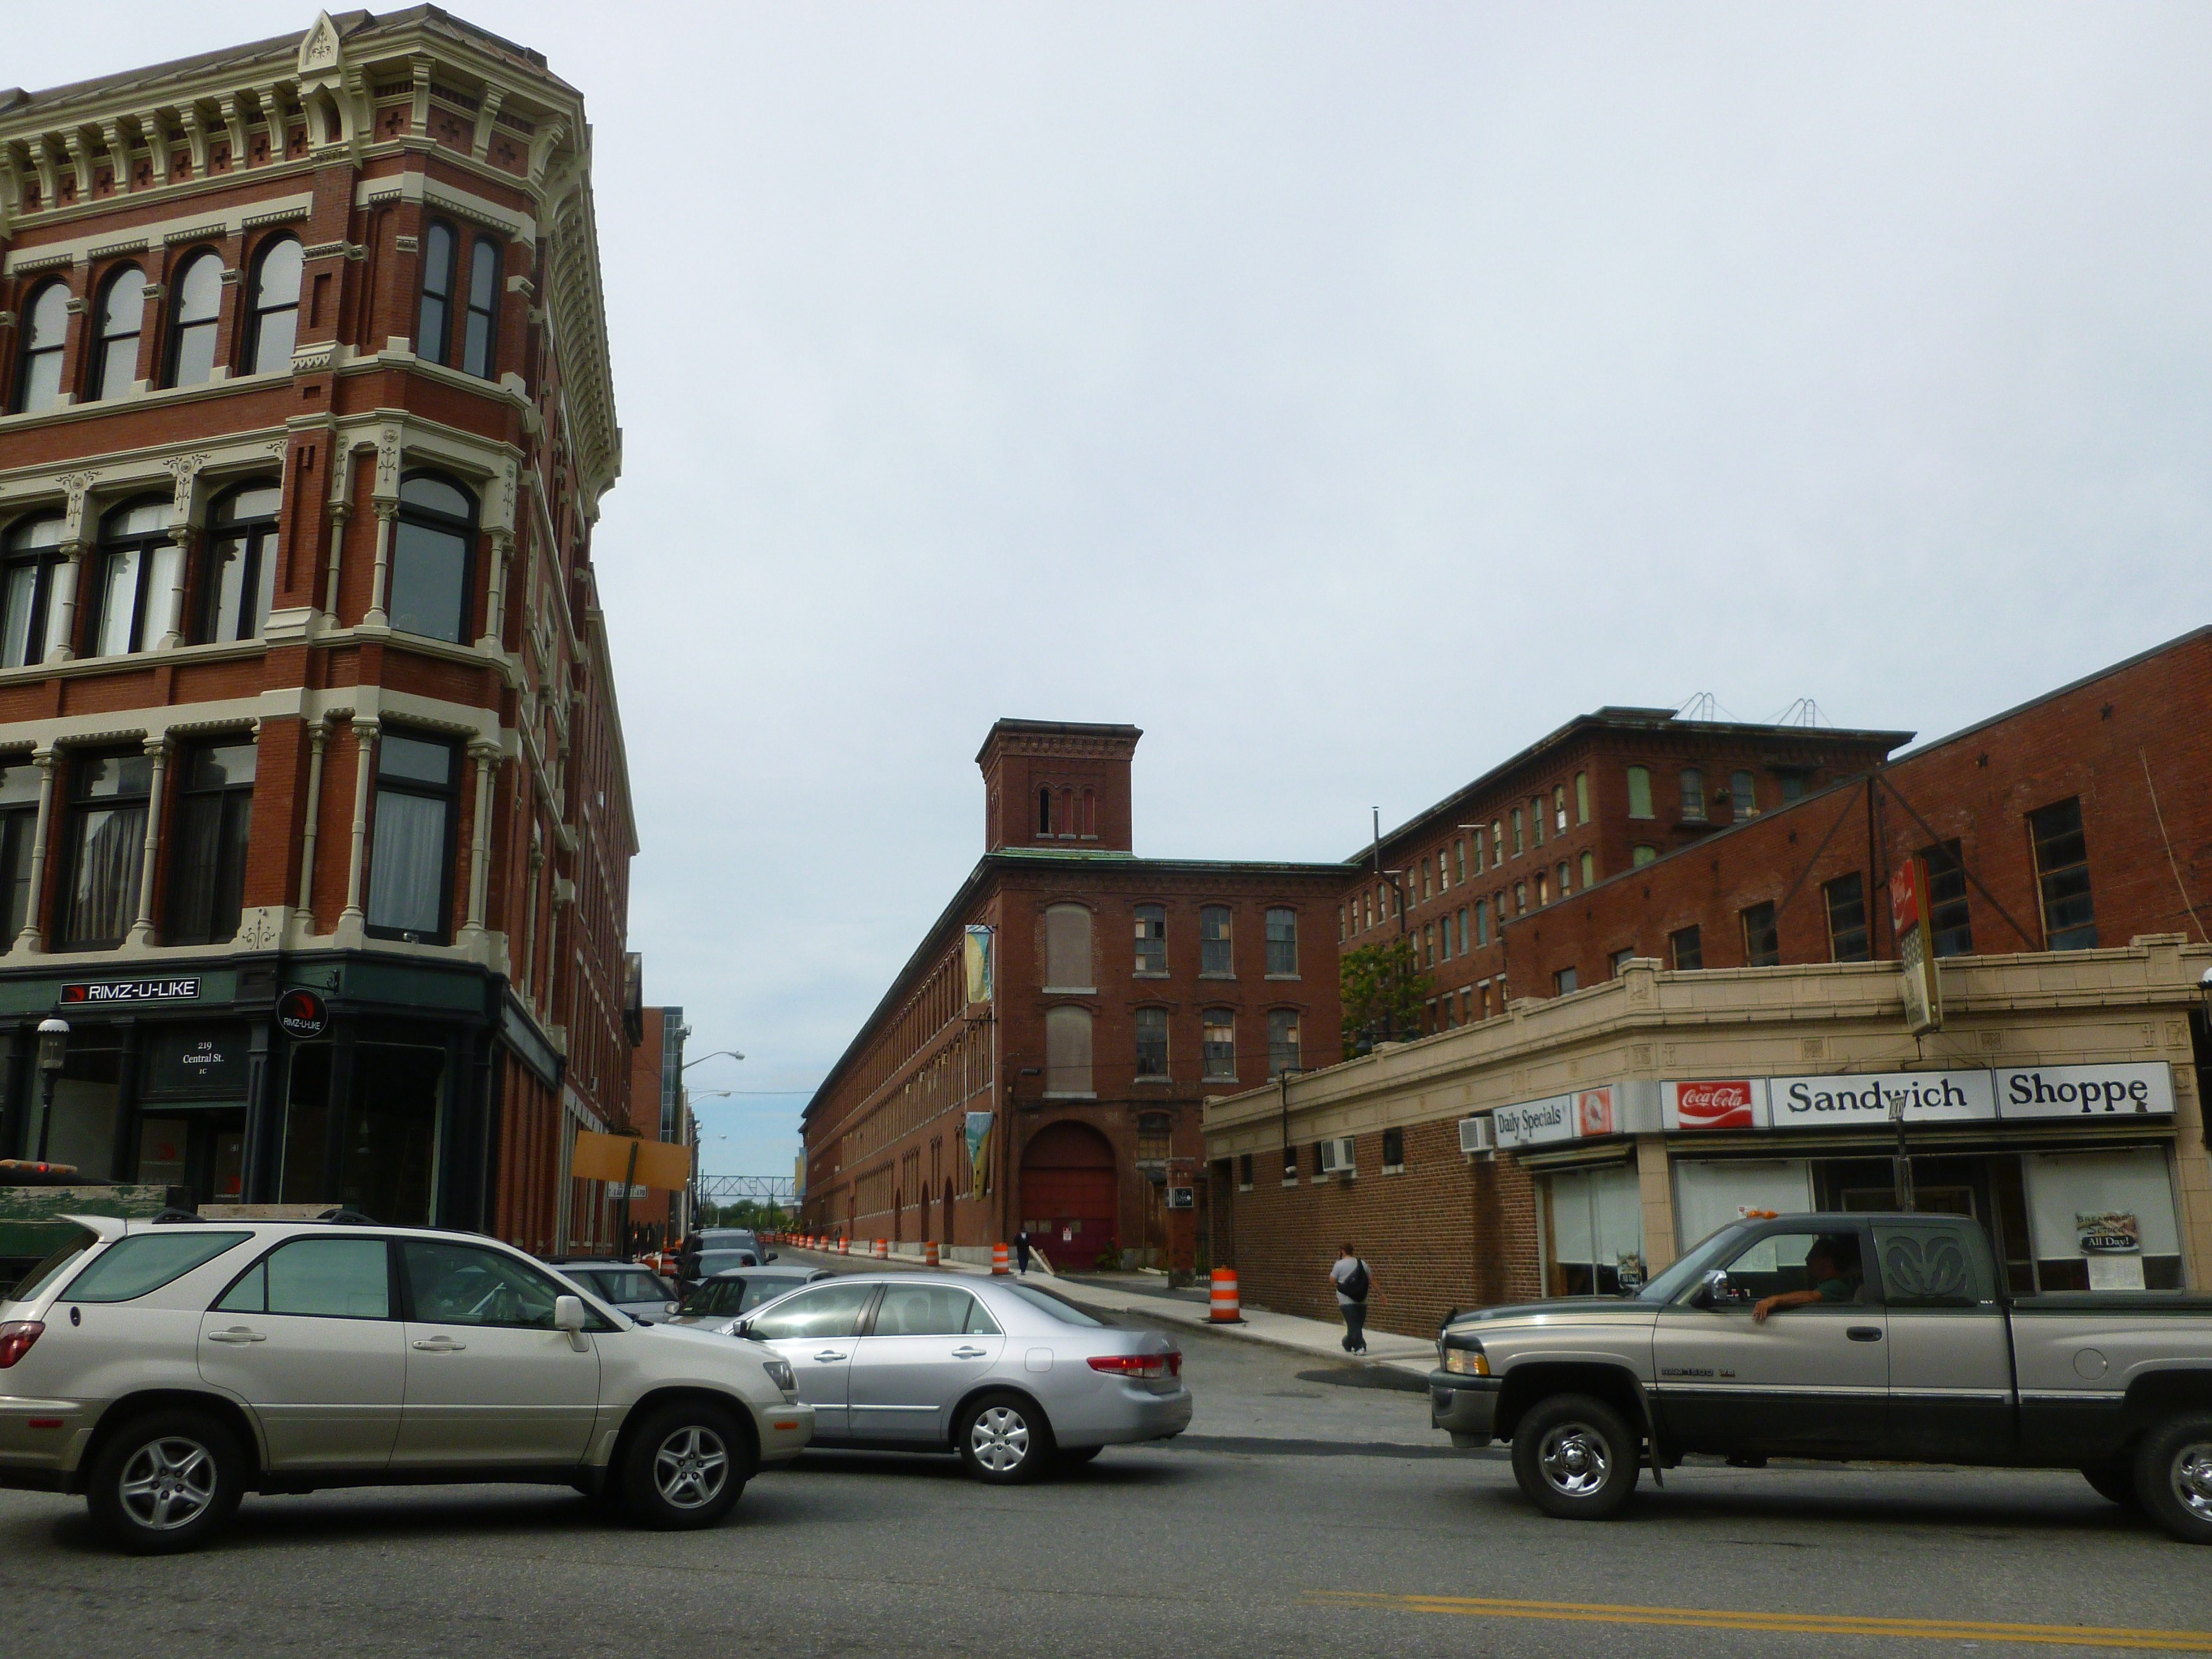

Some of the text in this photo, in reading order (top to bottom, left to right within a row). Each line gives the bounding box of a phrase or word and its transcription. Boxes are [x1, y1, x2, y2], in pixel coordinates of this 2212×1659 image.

[89, 981, 195, 1000] RIMZ-U-LIKE
[284, 1017, 321, 1030] RIMZ-U-LIKE
[198, 1042, 212, 1050] 219
[183, 1053, 224, 1063] Central St.
[1682, 1087, 1743, 1107] Coca-Cola
[1786, 1073, 2149, 1113] Sandwich Shoppe
[1498, 1104, 1561, 1141] Daily Specials
[2089, 1236, 2129, 1247] All Day!
